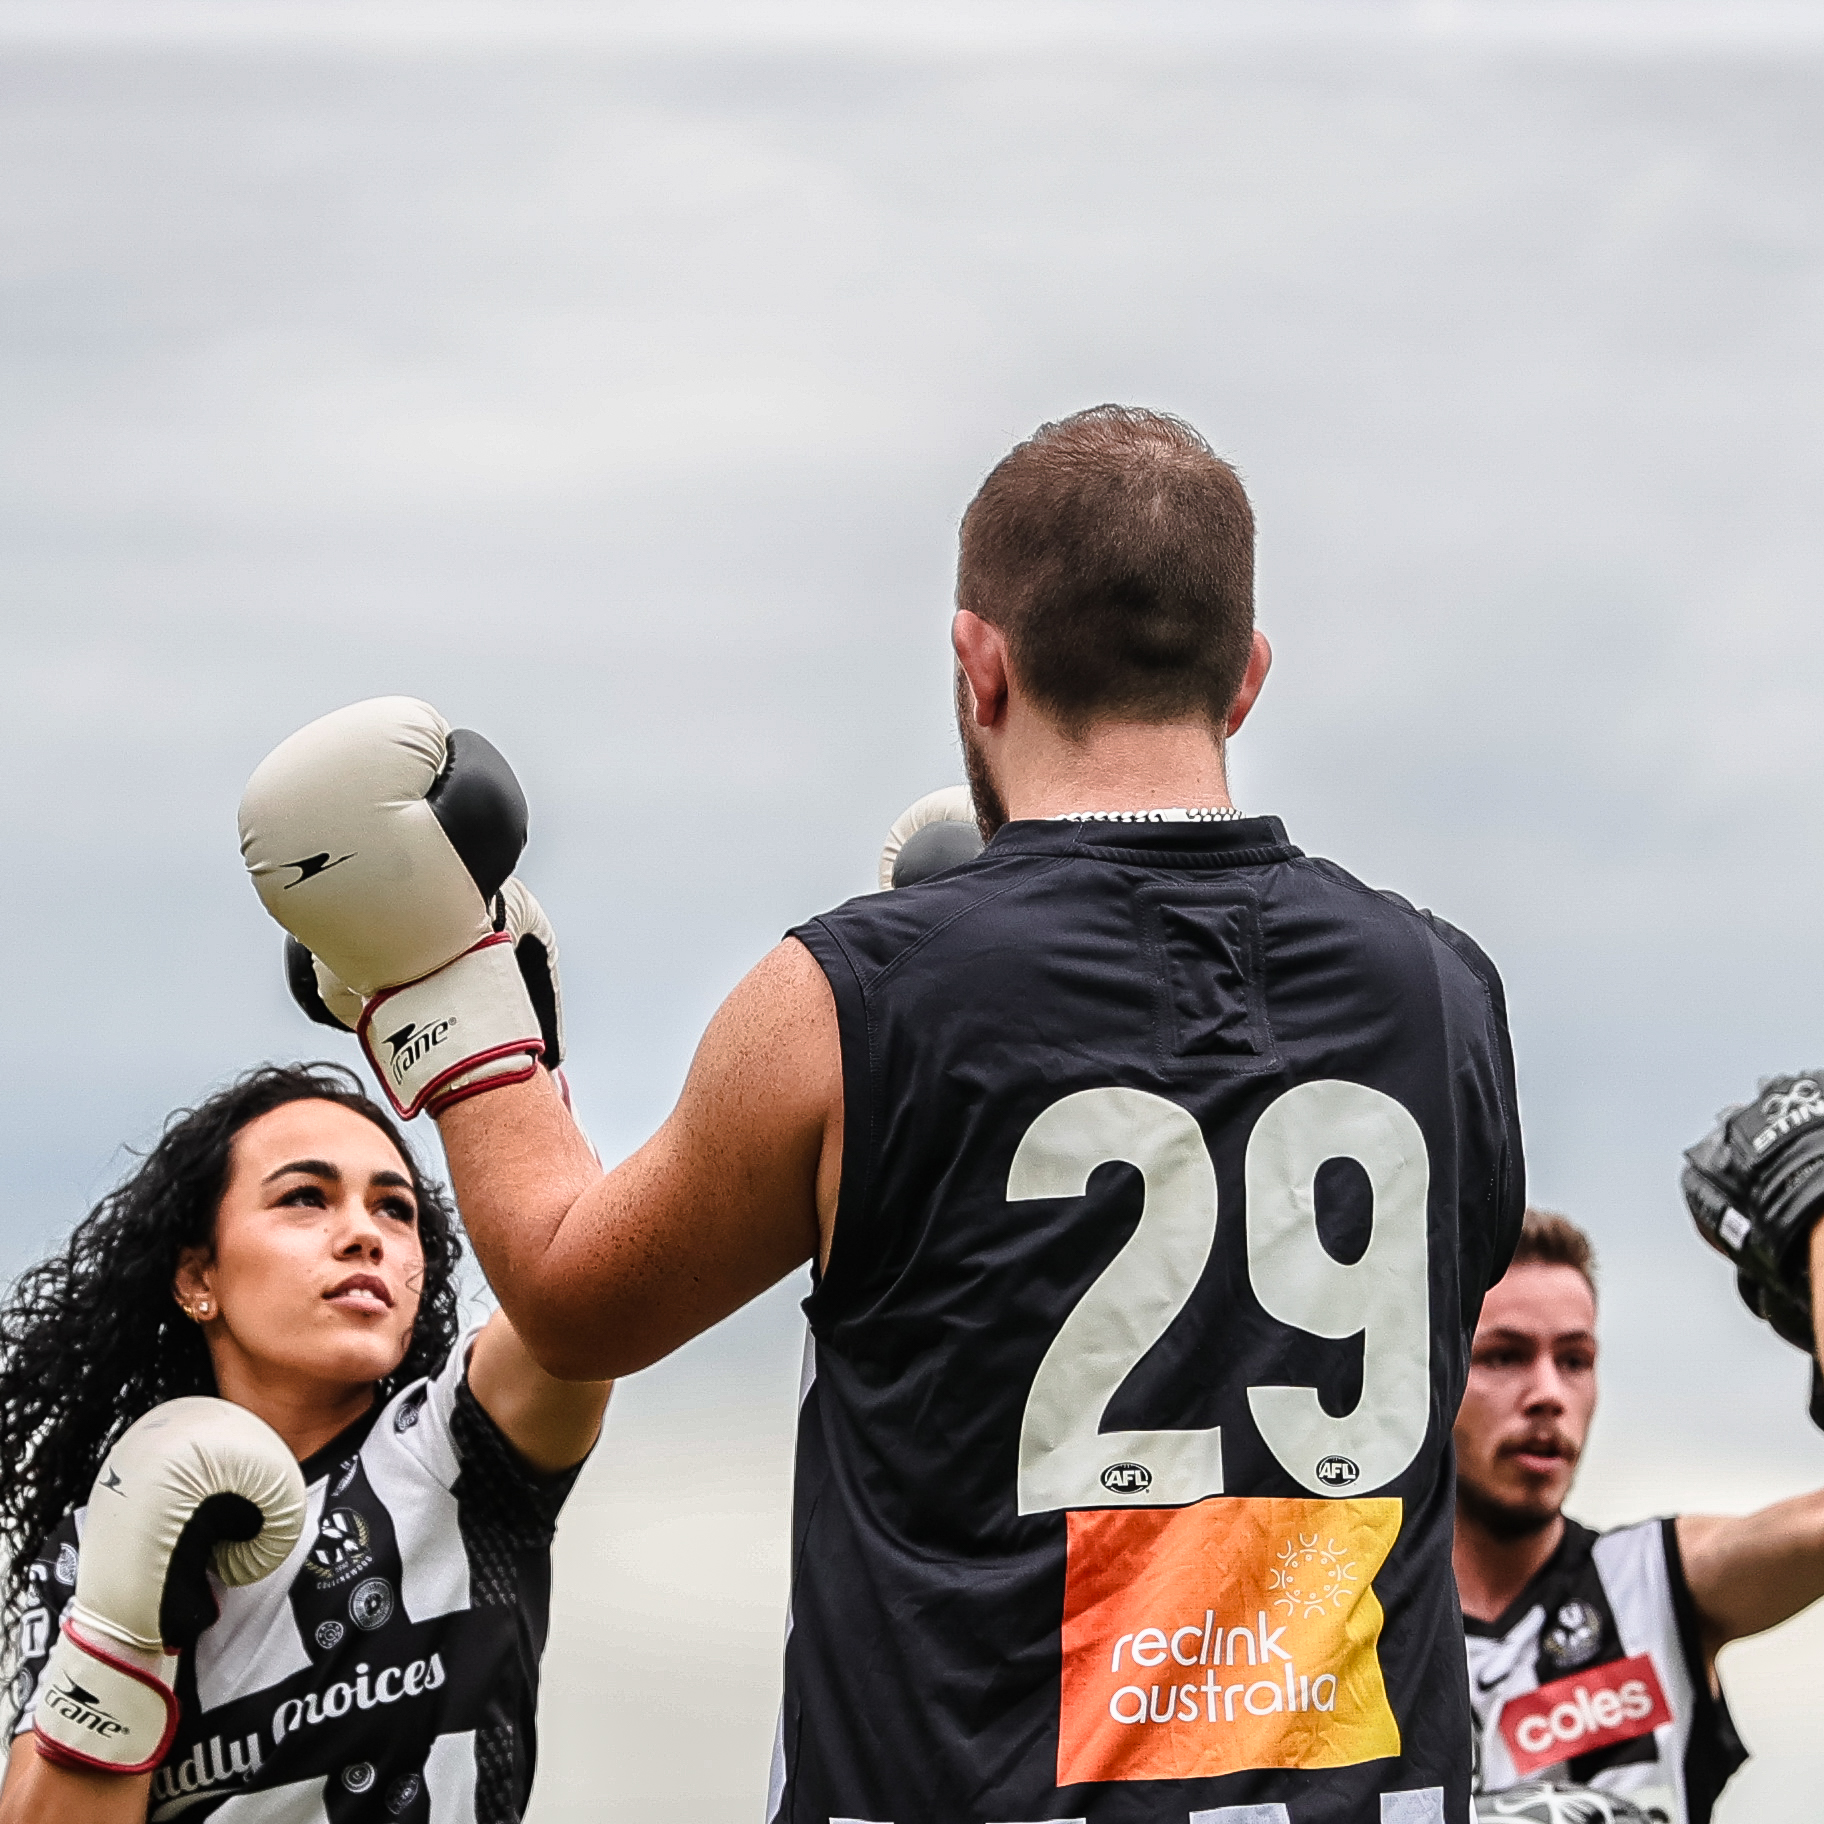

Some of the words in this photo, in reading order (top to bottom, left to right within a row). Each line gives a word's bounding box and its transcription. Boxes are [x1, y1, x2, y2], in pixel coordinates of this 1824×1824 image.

[1006, 1078, 1431, 1517] 29
[1105, 1470, 1149, 1487] AFL
[1318, 1462, 1356, 1479] AFL
[1110, 1610, 1290, 1674] reclink
[1108, 1666, 1338, 1725] australia
[1517, 1680, 1652, 1753] coles
